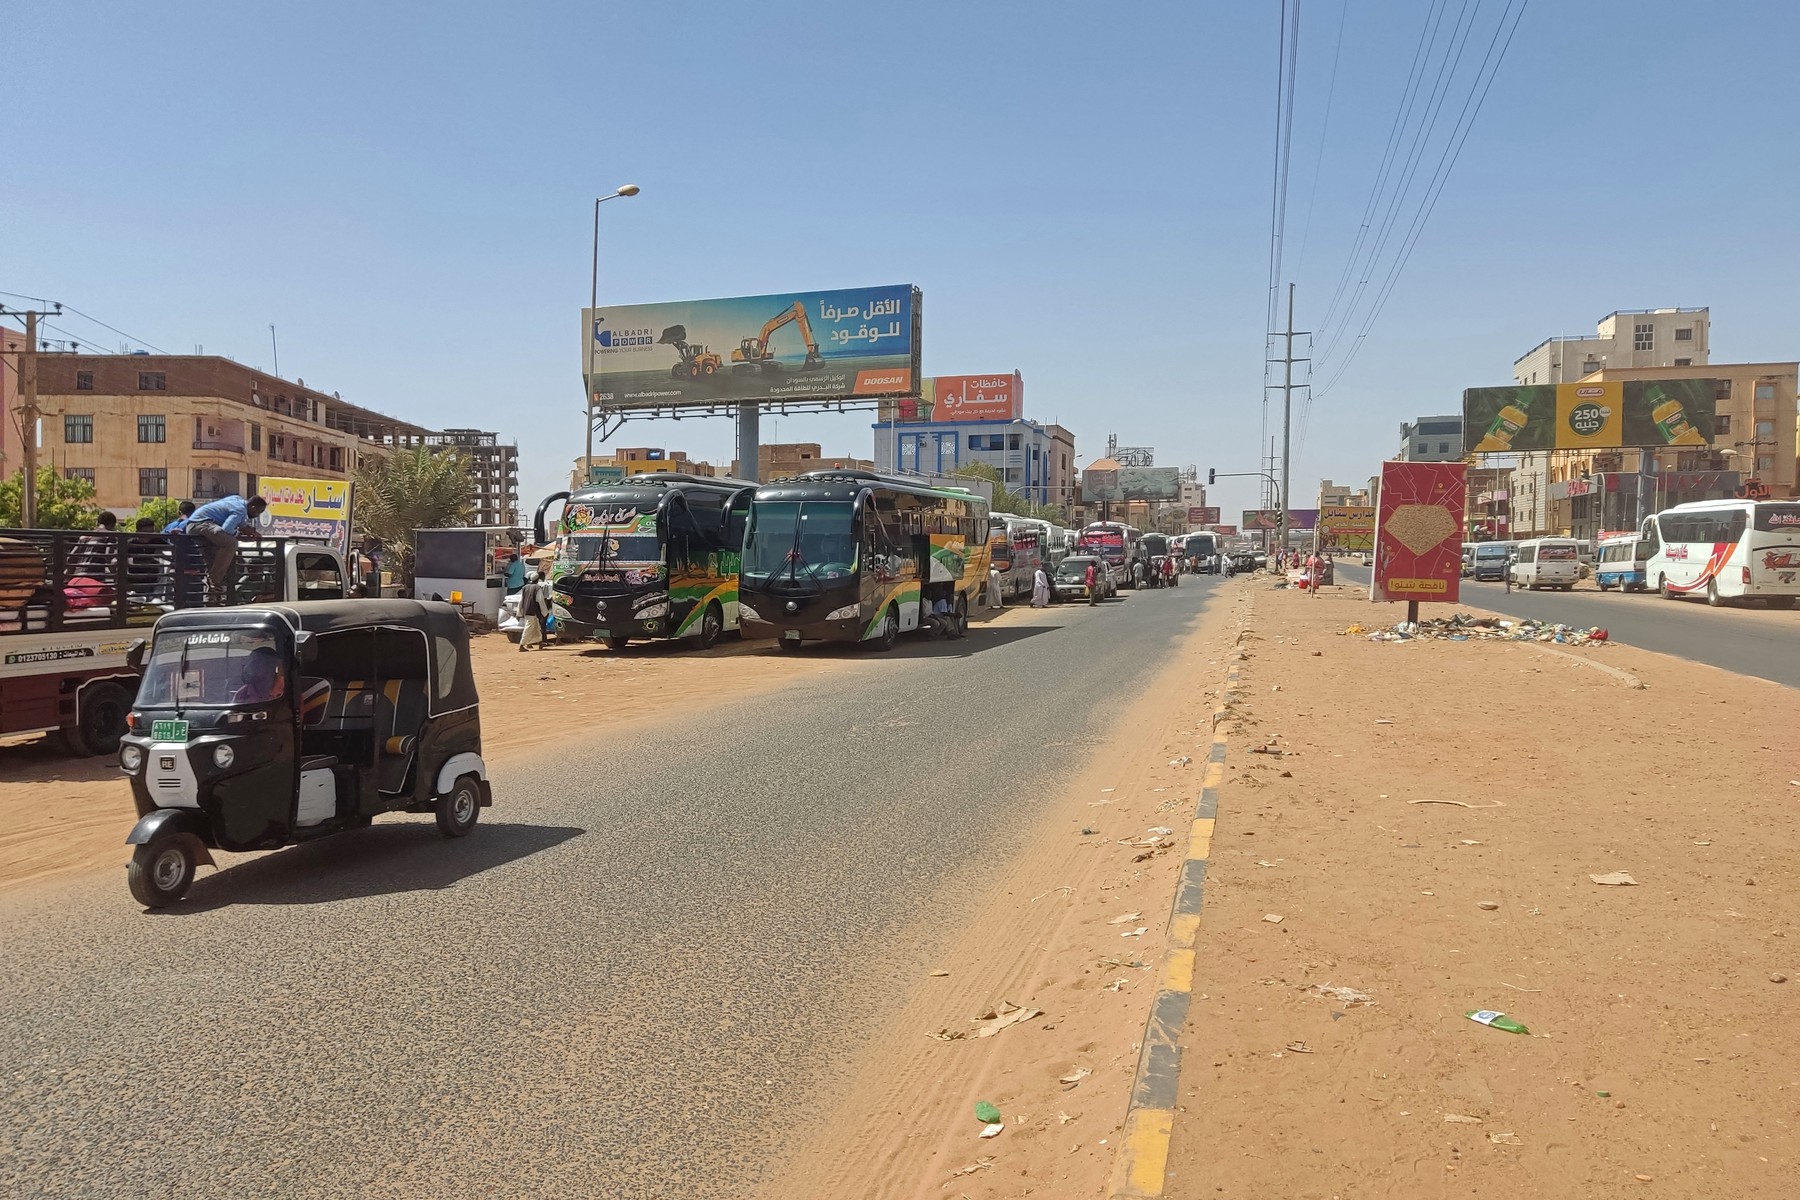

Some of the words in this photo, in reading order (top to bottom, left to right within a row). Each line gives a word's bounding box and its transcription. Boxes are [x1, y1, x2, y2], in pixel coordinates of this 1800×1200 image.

[862, 298, 900, 320] الأقل
[612, 328, 652, 337] ALBADRI
[830, 322, 900, 344] للوقود
[613, 336, 653, 346] POWER
[864, 376, 903, 385] DOOSAN
[970, 377, 1008, 389] حافظات
[624, 390, 681, 398] www.albadripower.com
[943, 380, 1008, 408] سفاري
[1574, 409, 1599, 420] 250
[1575, 419, 1599, 431] جنيه
[303, 486, 346, 516] إستار
